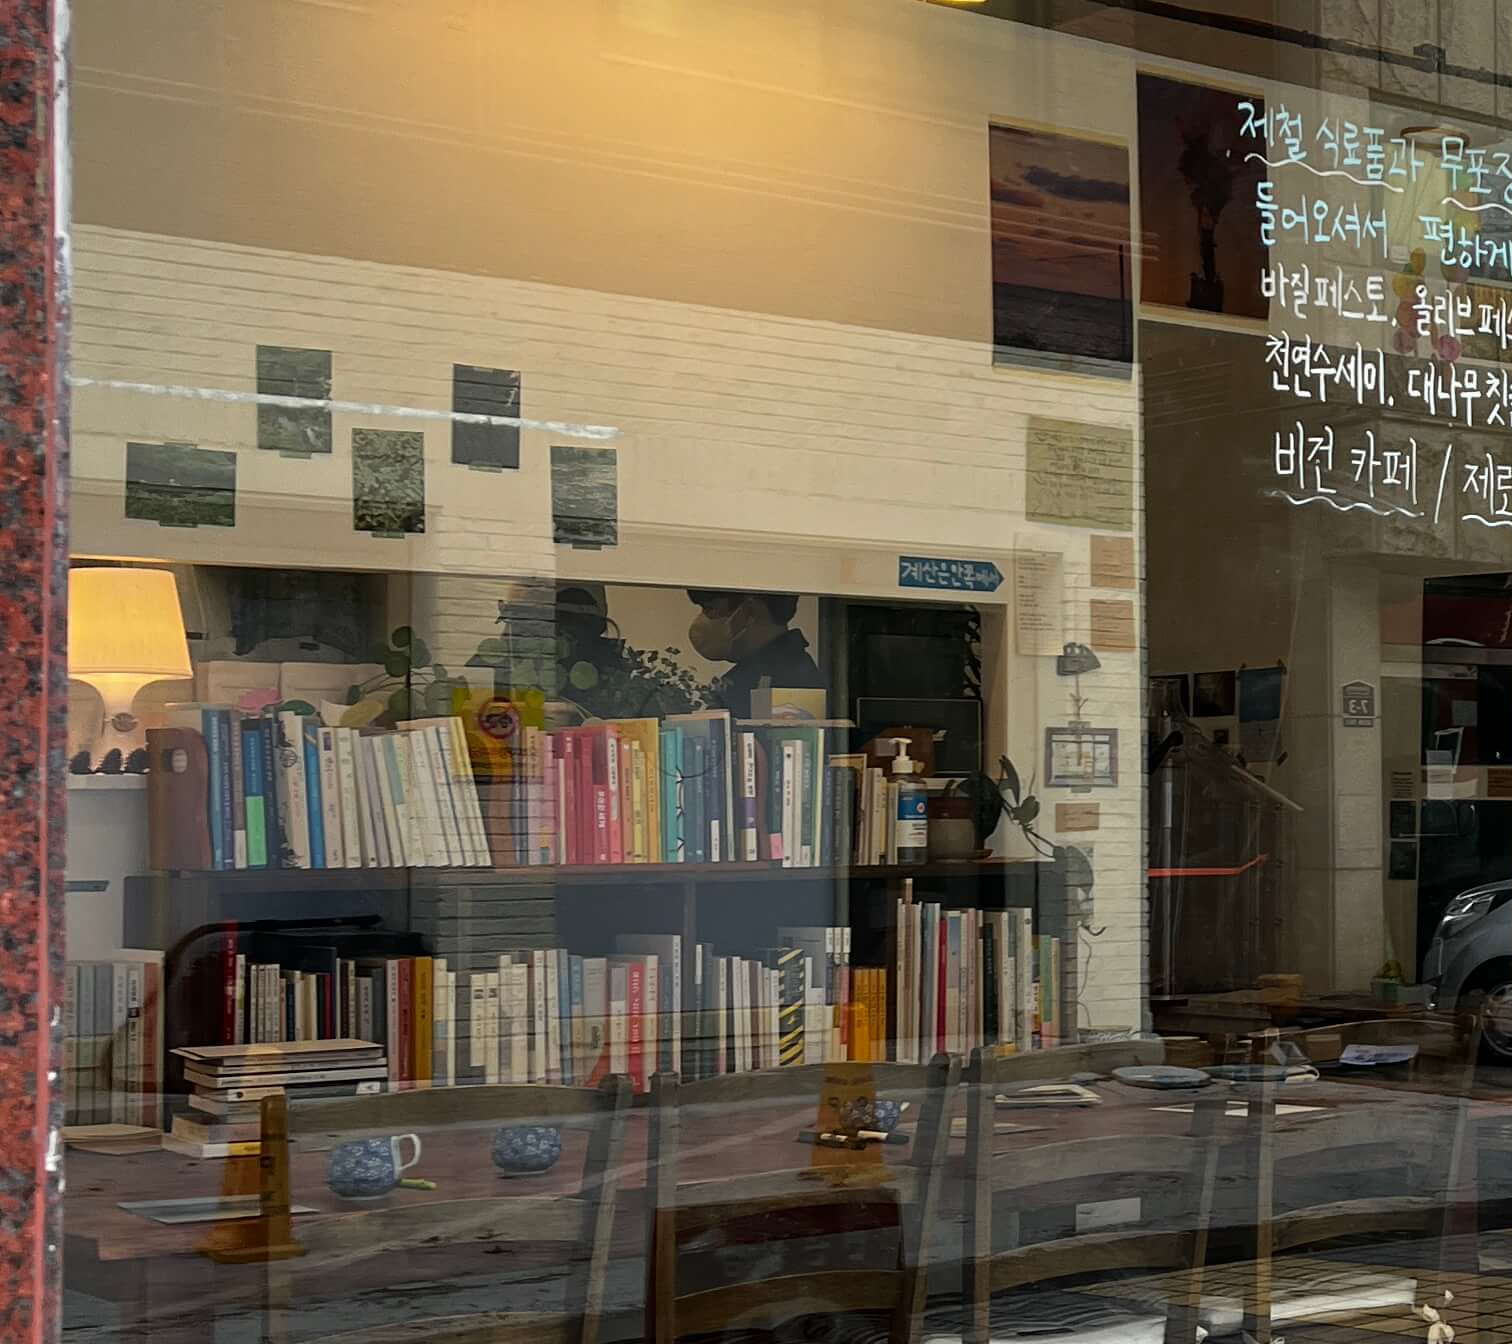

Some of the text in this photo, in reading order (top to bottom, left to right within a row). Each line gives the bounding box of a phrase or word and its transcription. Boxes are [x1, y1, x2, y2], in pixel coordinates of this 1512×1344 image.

[1238, 103, 1307, 161] 제철
[1316, 117, 1425, 181] 식료품과
[1256, 181, 1388, 259] 들어오셔서
[1275, 421, 1337, 494] 비건
[1351, 430, 1418, 506] 카페
